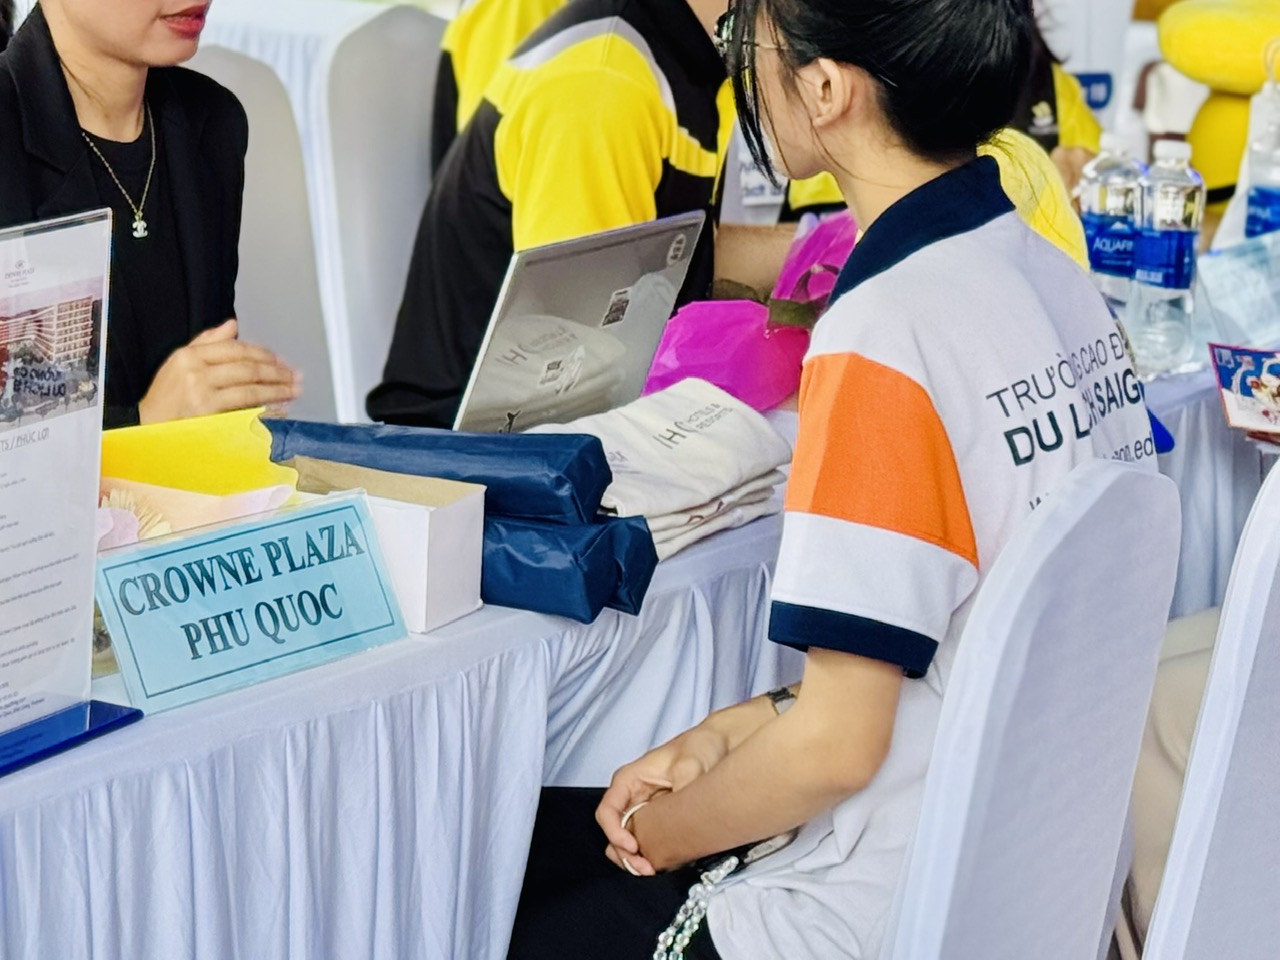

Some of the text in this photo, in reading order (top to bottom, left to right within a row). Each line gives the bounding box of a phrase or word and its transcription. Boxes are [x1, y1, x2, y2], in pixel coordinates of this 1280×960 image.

[1003, 409, 1064, 467] DU
[118, 550, 263, 617] CROWNE
[260, 520, 366, 579] PLAZA
[180, 582, 344, 662] PHU QUOC
